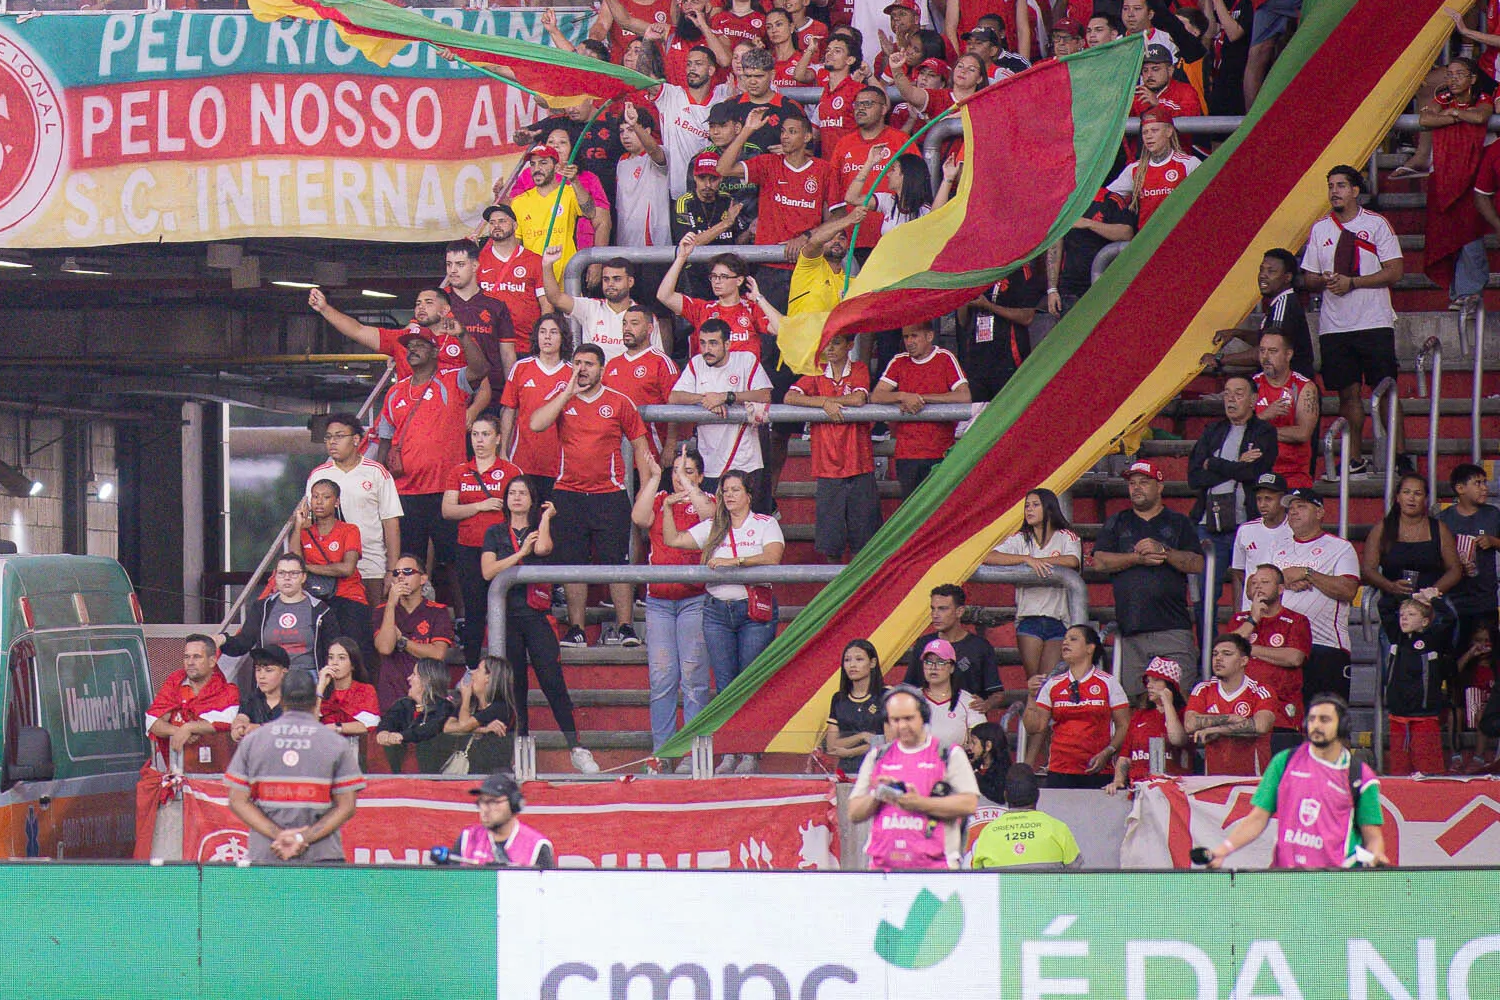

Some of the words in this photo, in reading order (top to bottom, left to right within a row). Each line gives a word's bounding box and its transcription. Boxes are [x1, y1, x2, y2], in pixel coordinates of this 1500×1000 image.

[98, 12, 248, 78] PELO
[81, 85, 228, 159] PELO
[250, 80, 444, 151] NOSSO
[464, 83, 549, 149] AM
[193, 156, 503, 233] INTERNAC
[781, 196, 816, 209] Banrisul
[460, 482, 501, 493] Banrsul
[65, 682, 119, 735] Unimed
[270, 724, 318, 736] STAFF
[274, 737, 312, 750] 0733
[881, 811, 924, 831] RÁDIO
[991, 821, 1042, 833] ORIENTADOR
[1004, 830, 1036, 841] 1298
[1284, 828, 1324, 851] RÁDIO
[1125, 939, 1308, 1000] DA
